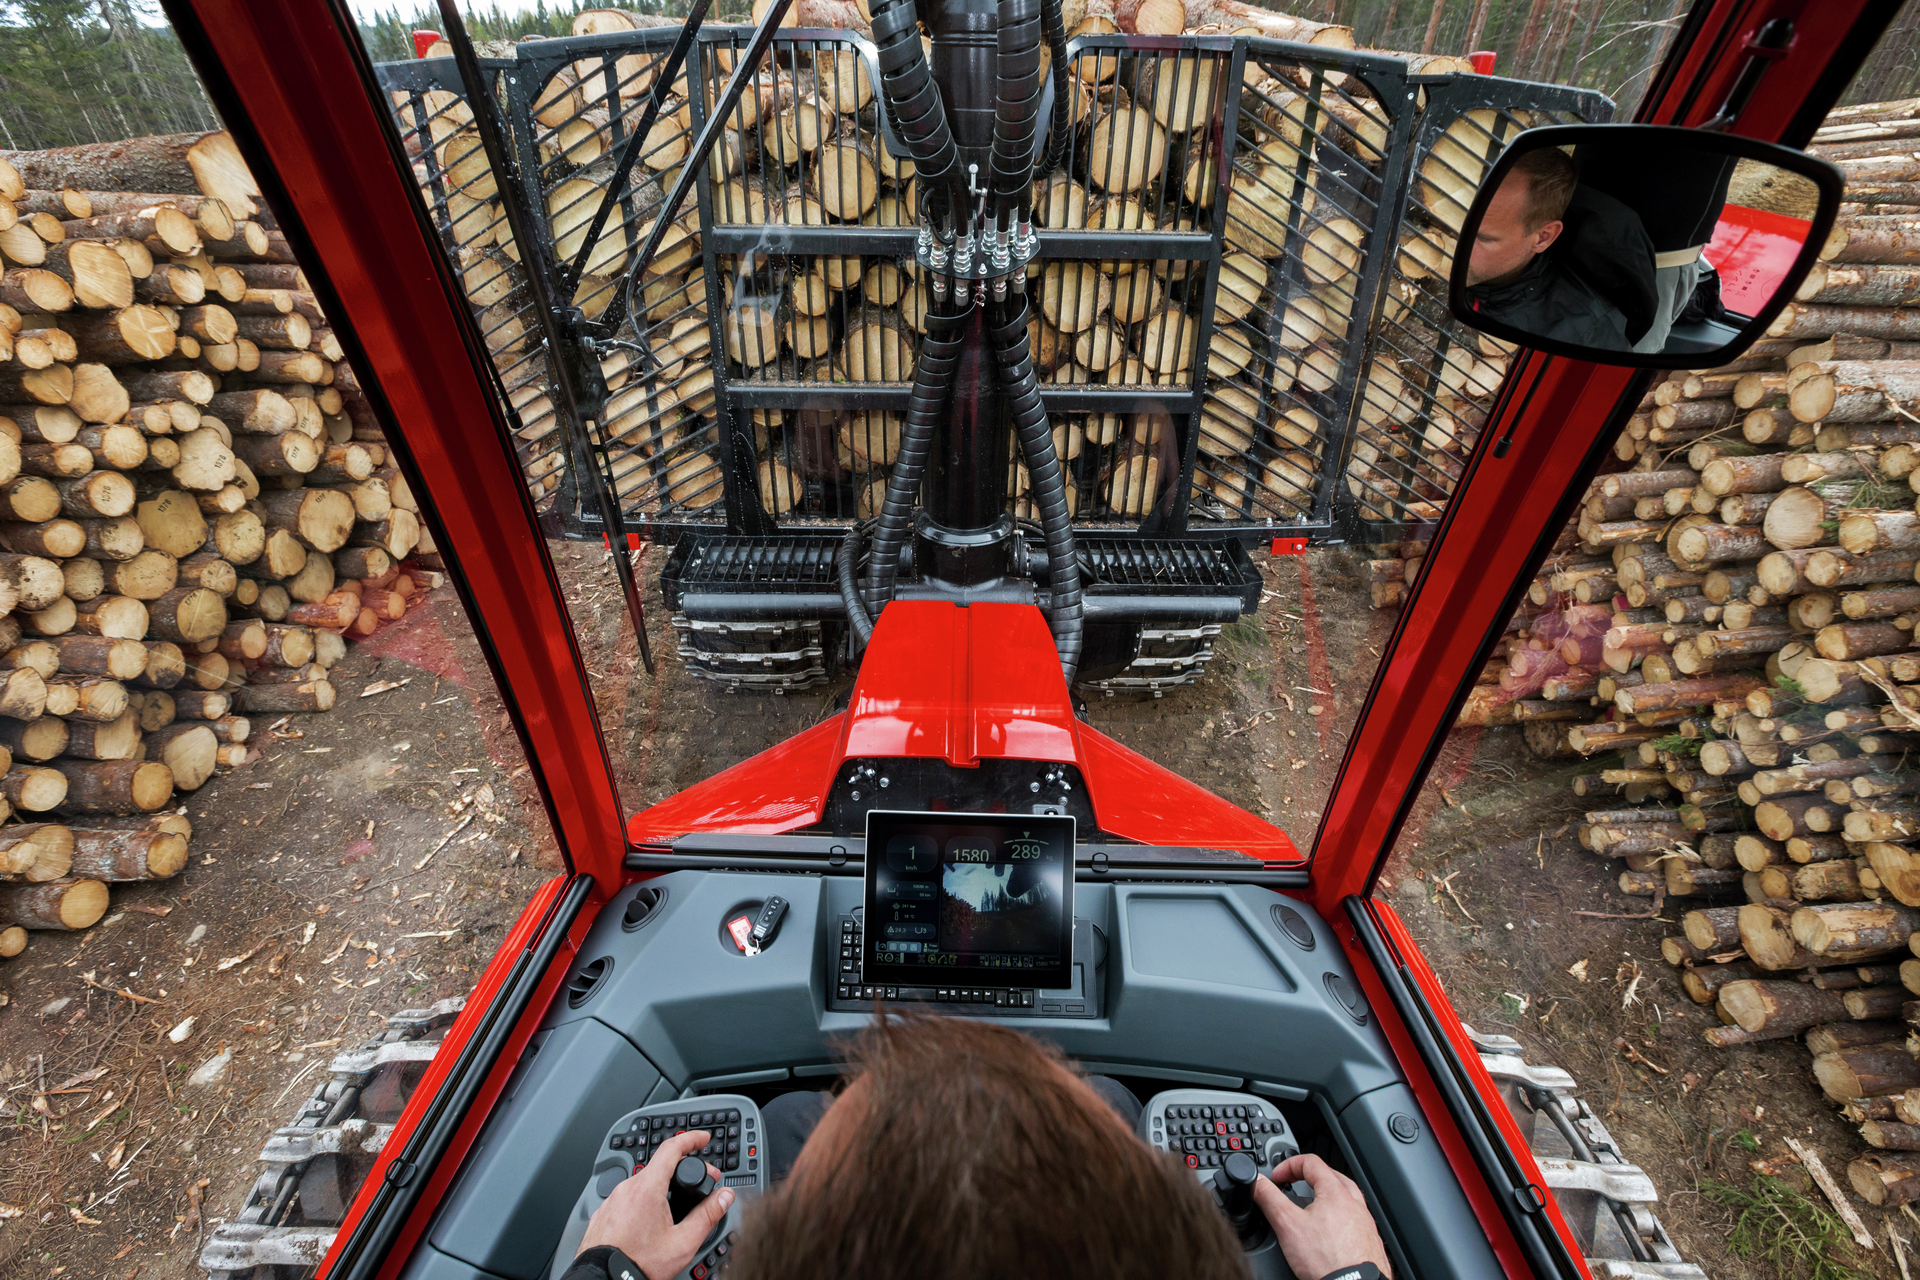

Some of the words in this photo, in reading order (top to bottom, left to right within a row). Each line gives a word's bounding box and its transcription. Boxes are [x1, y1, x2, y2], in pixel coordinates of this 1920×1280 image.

[214, 454, 227, 469] 1376
[157, 498, 172, 513] 1376
[909, 845, 915, 860] 1
[953, 848, 989, 861] 1580
[1011, 844, 1041, 859] 289
